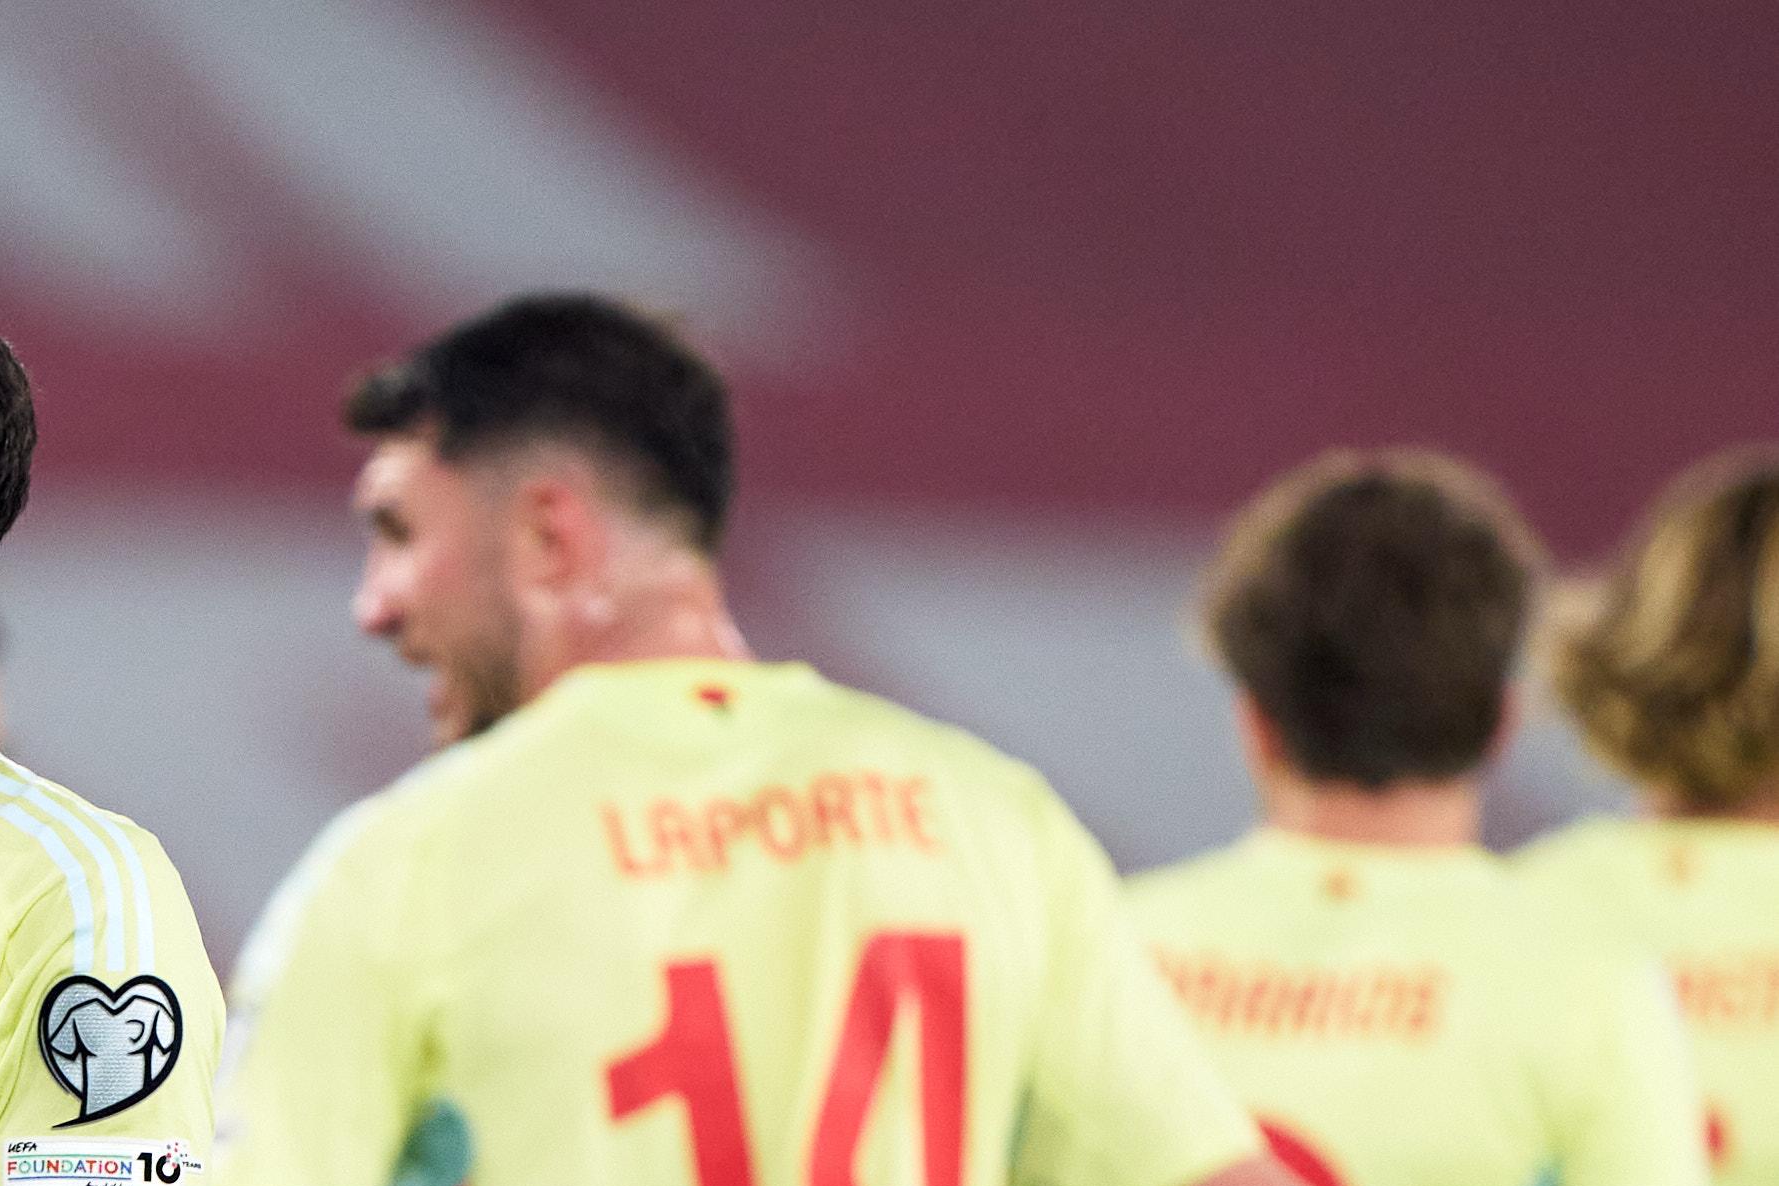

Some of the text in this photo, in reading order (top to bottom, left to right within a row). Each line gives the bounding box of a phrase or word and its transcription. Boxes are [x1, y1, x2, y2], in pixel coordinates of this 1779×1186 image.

[600, 772, 944, 878] LAPORTE
[7, 1142, 38, 1153] UEFA
[7, 1159, 132, 1175] FOUNDATION
[137, 1152, 181, 1184] 10
